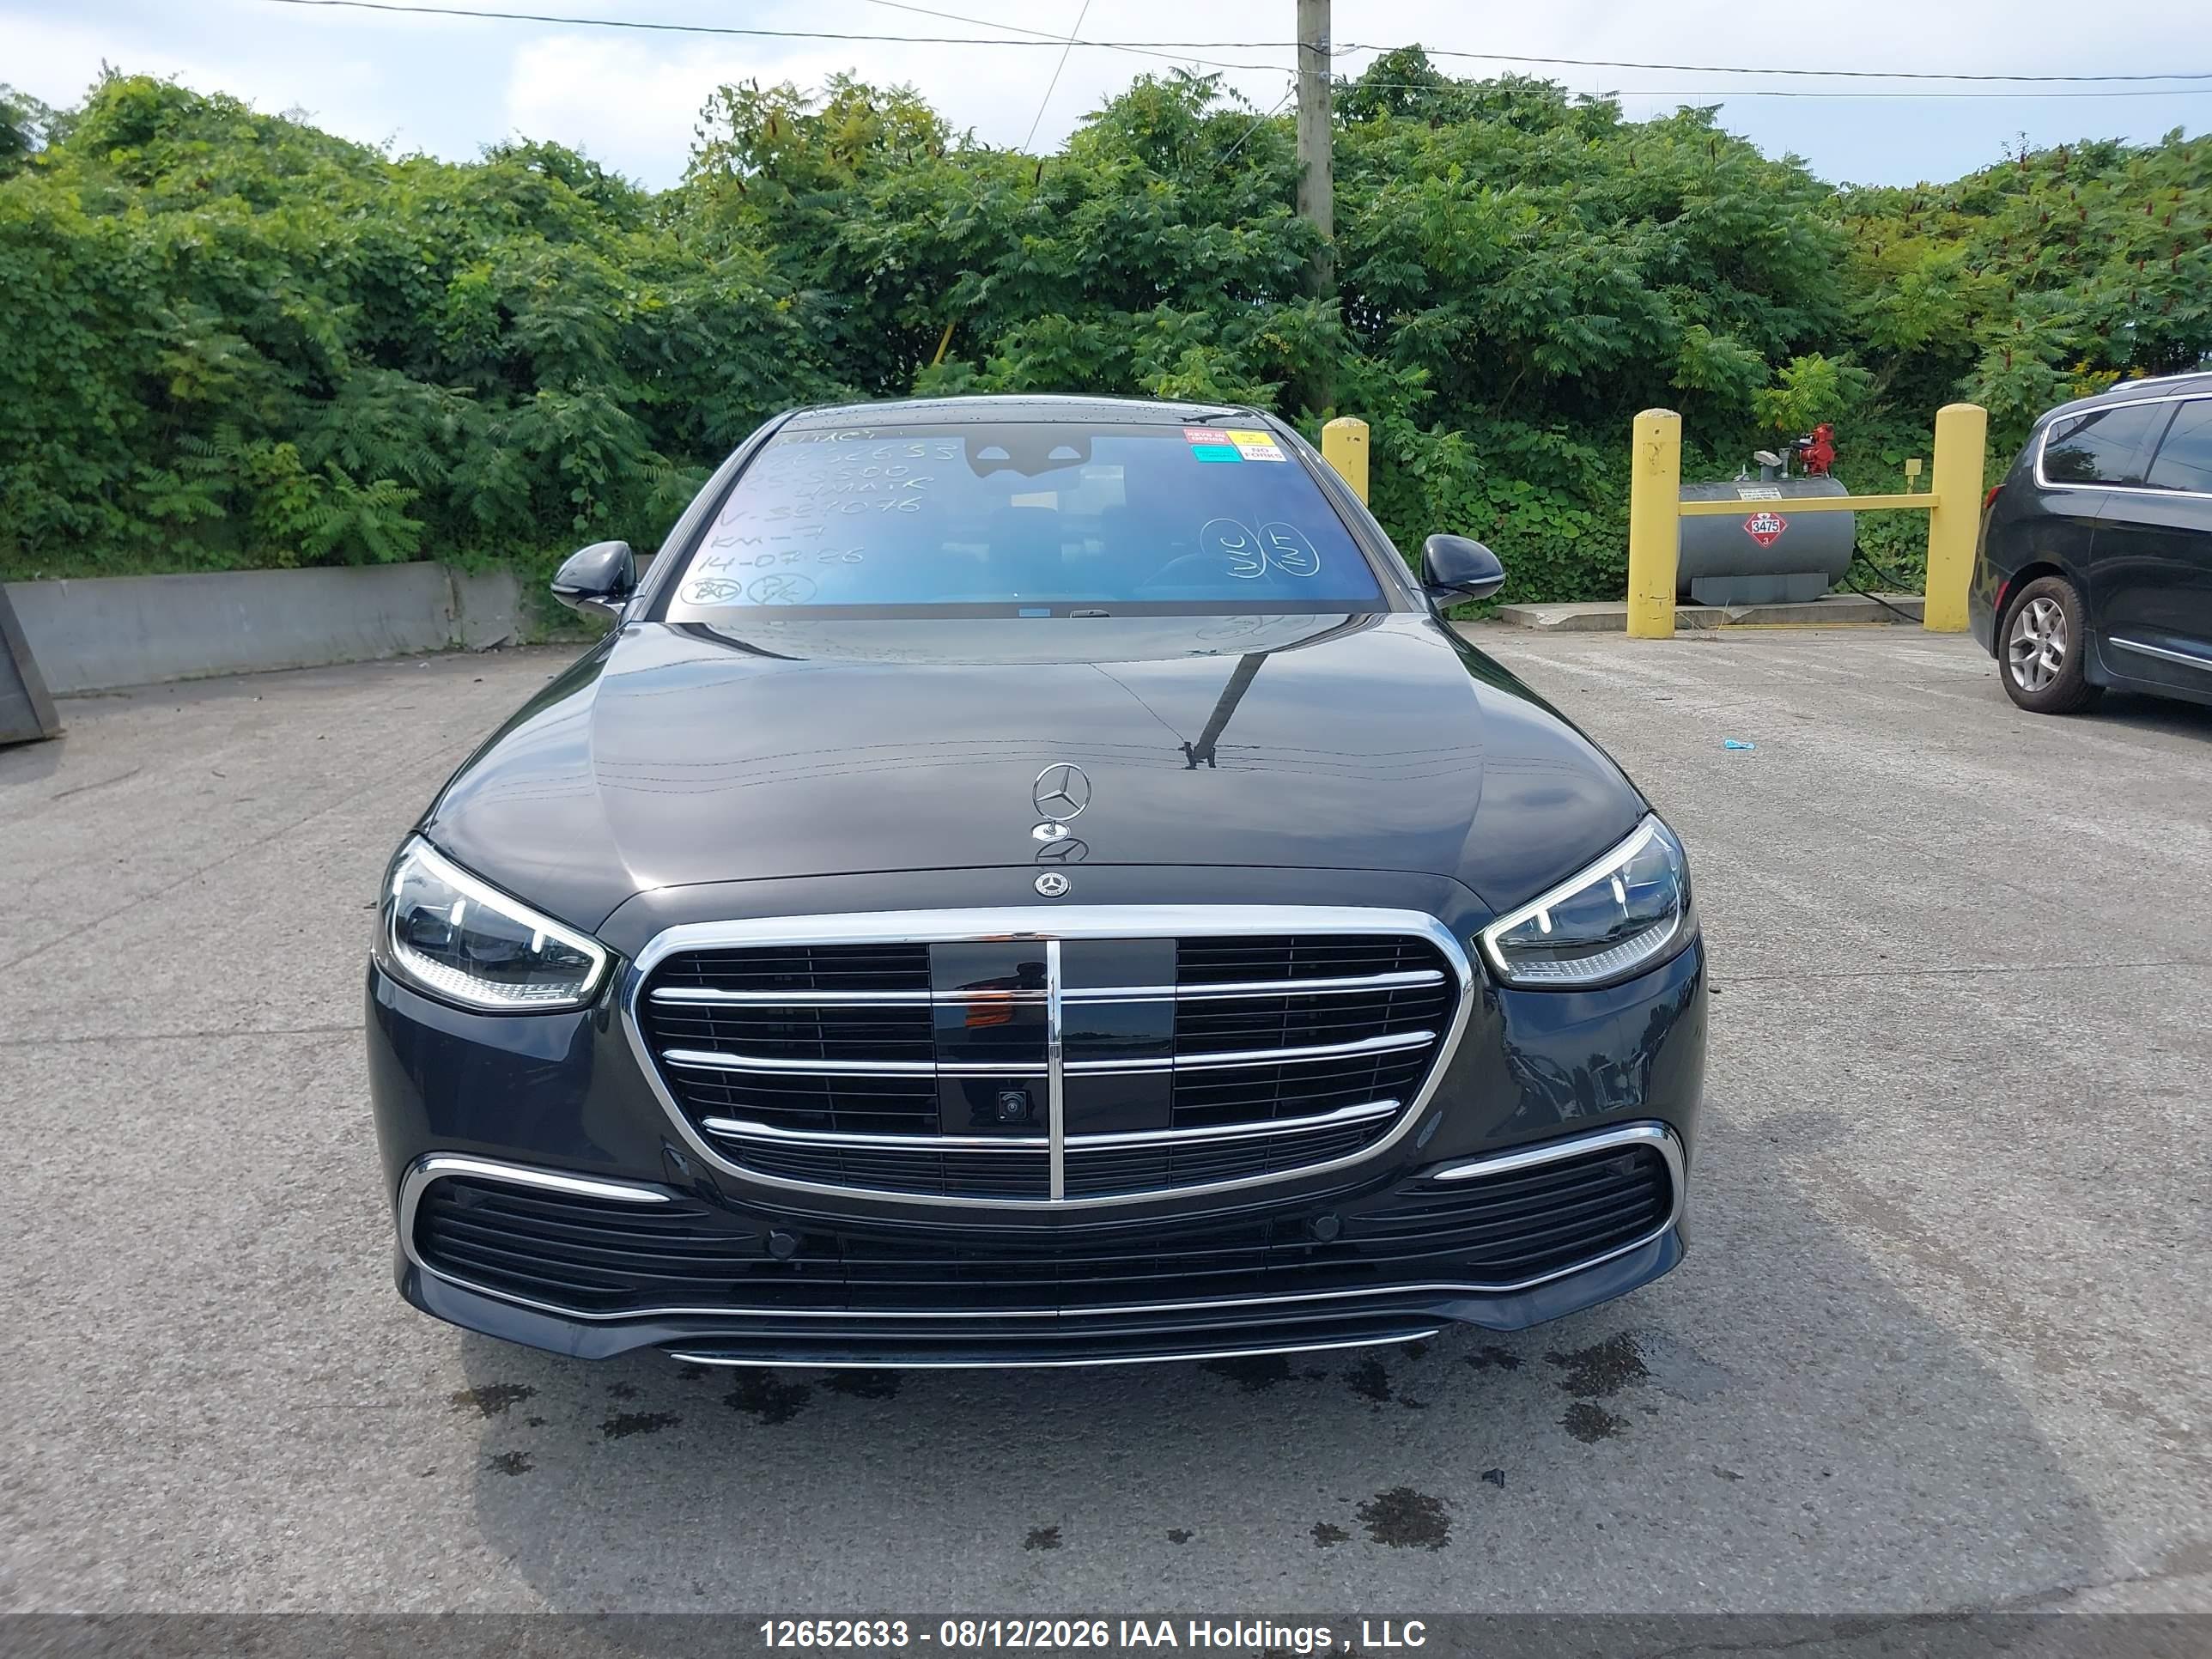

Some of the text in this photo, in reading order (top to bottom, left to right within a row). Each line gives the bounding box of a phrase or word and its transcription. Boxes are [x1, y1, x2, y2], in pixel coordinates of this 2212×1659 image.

[1753, 520, 1778, 532] 3475
[1267, 527, 1308, 567] INT
[1763, 537, 1770, 545] 3
